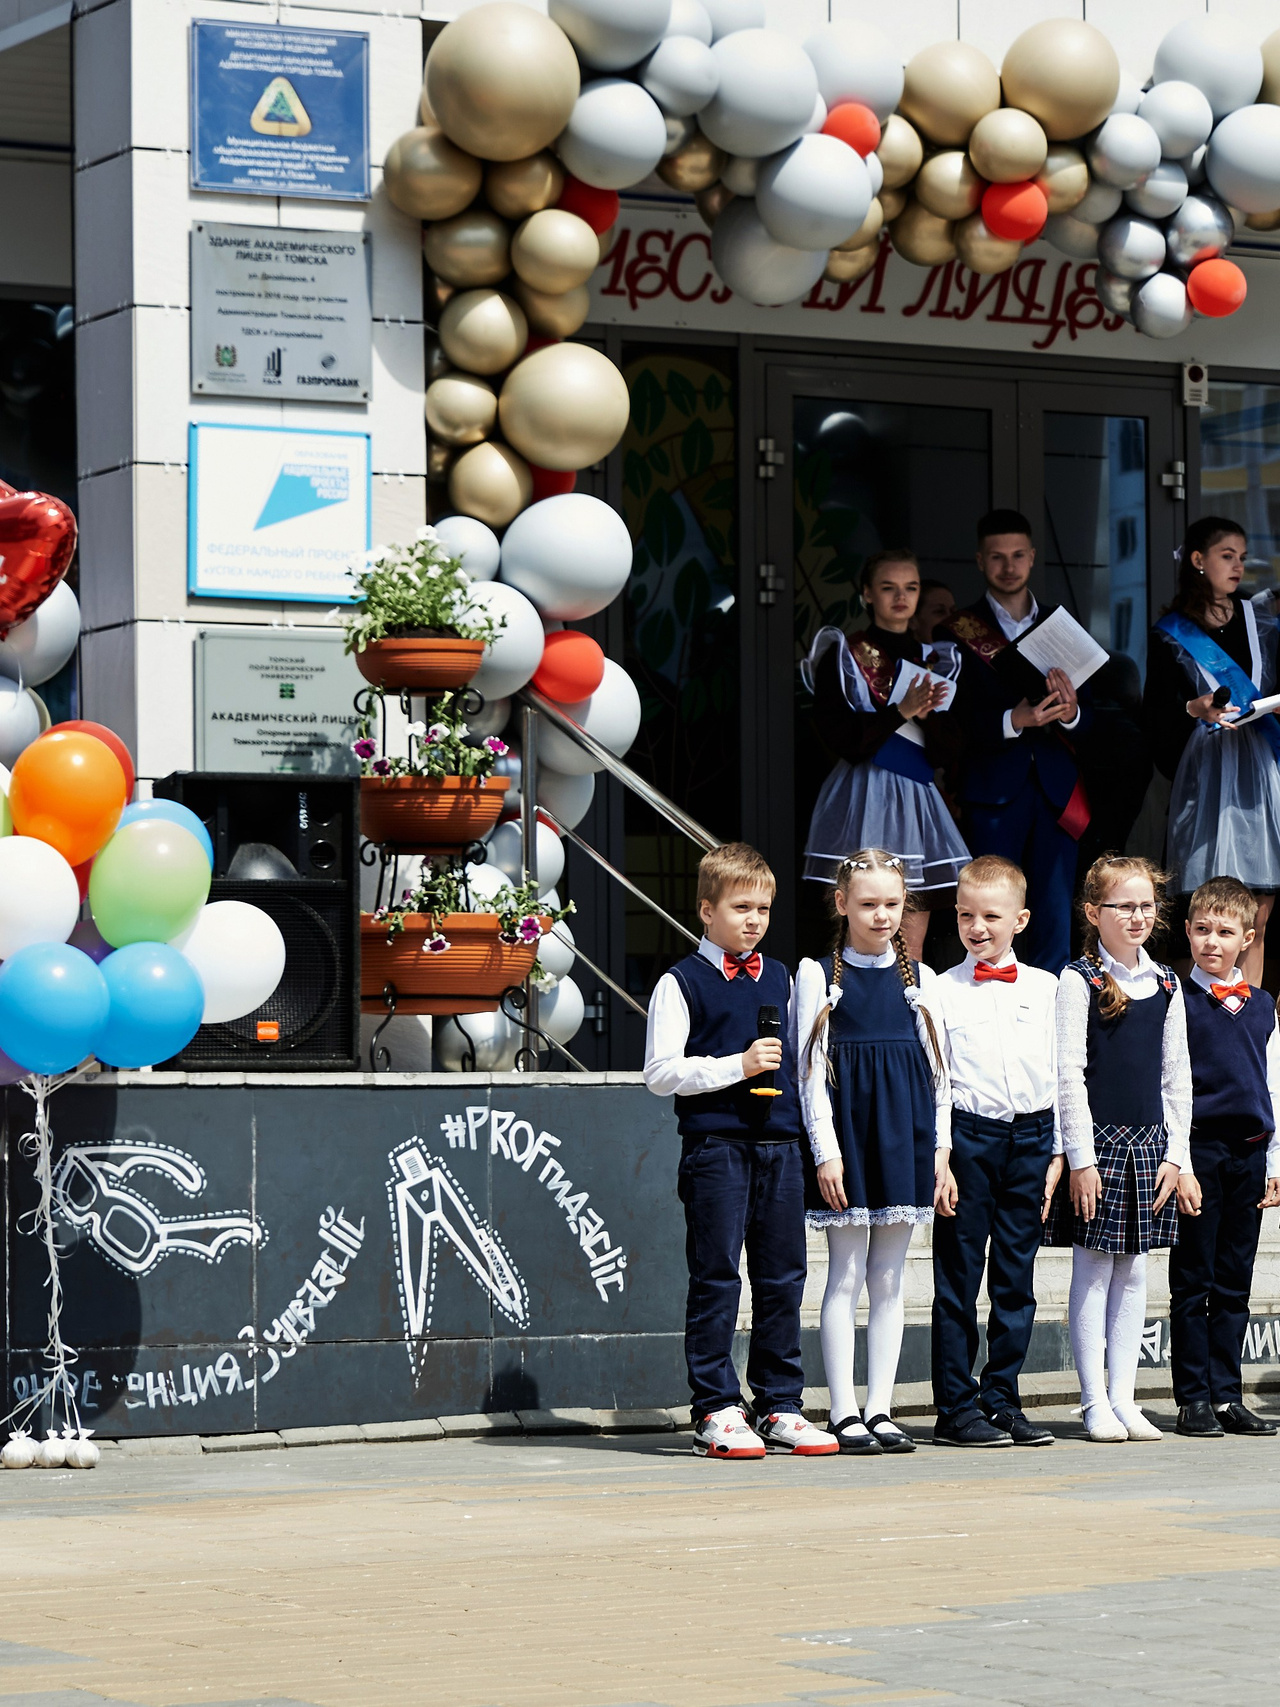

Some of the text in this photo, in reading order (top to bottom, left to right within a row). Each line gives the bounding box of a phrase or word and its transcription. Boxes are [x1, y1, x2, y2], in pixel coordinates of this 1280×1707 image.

[209, 236, 356, 256] ЗДАНИЕ АКАДЕМИЧЕСКОГО
[236, 251, 273, 263] ЛИЦЕЯ
[285, 254, 329, 266] ТОМСКА
[297, 375, 360, 388] ГАЗПРОМБАНК
[207, 543, 304, 560] ФЕДЕРАЛЬНЫЙ
[268, 656, 306, 664] ТОМСКИЙ
[248, 664, 326, 673] ПОЛИТЕХНИЧЕСКИЙ
[211, 712, 317, 724] АКАДЕМИЧЕСКИЙ
